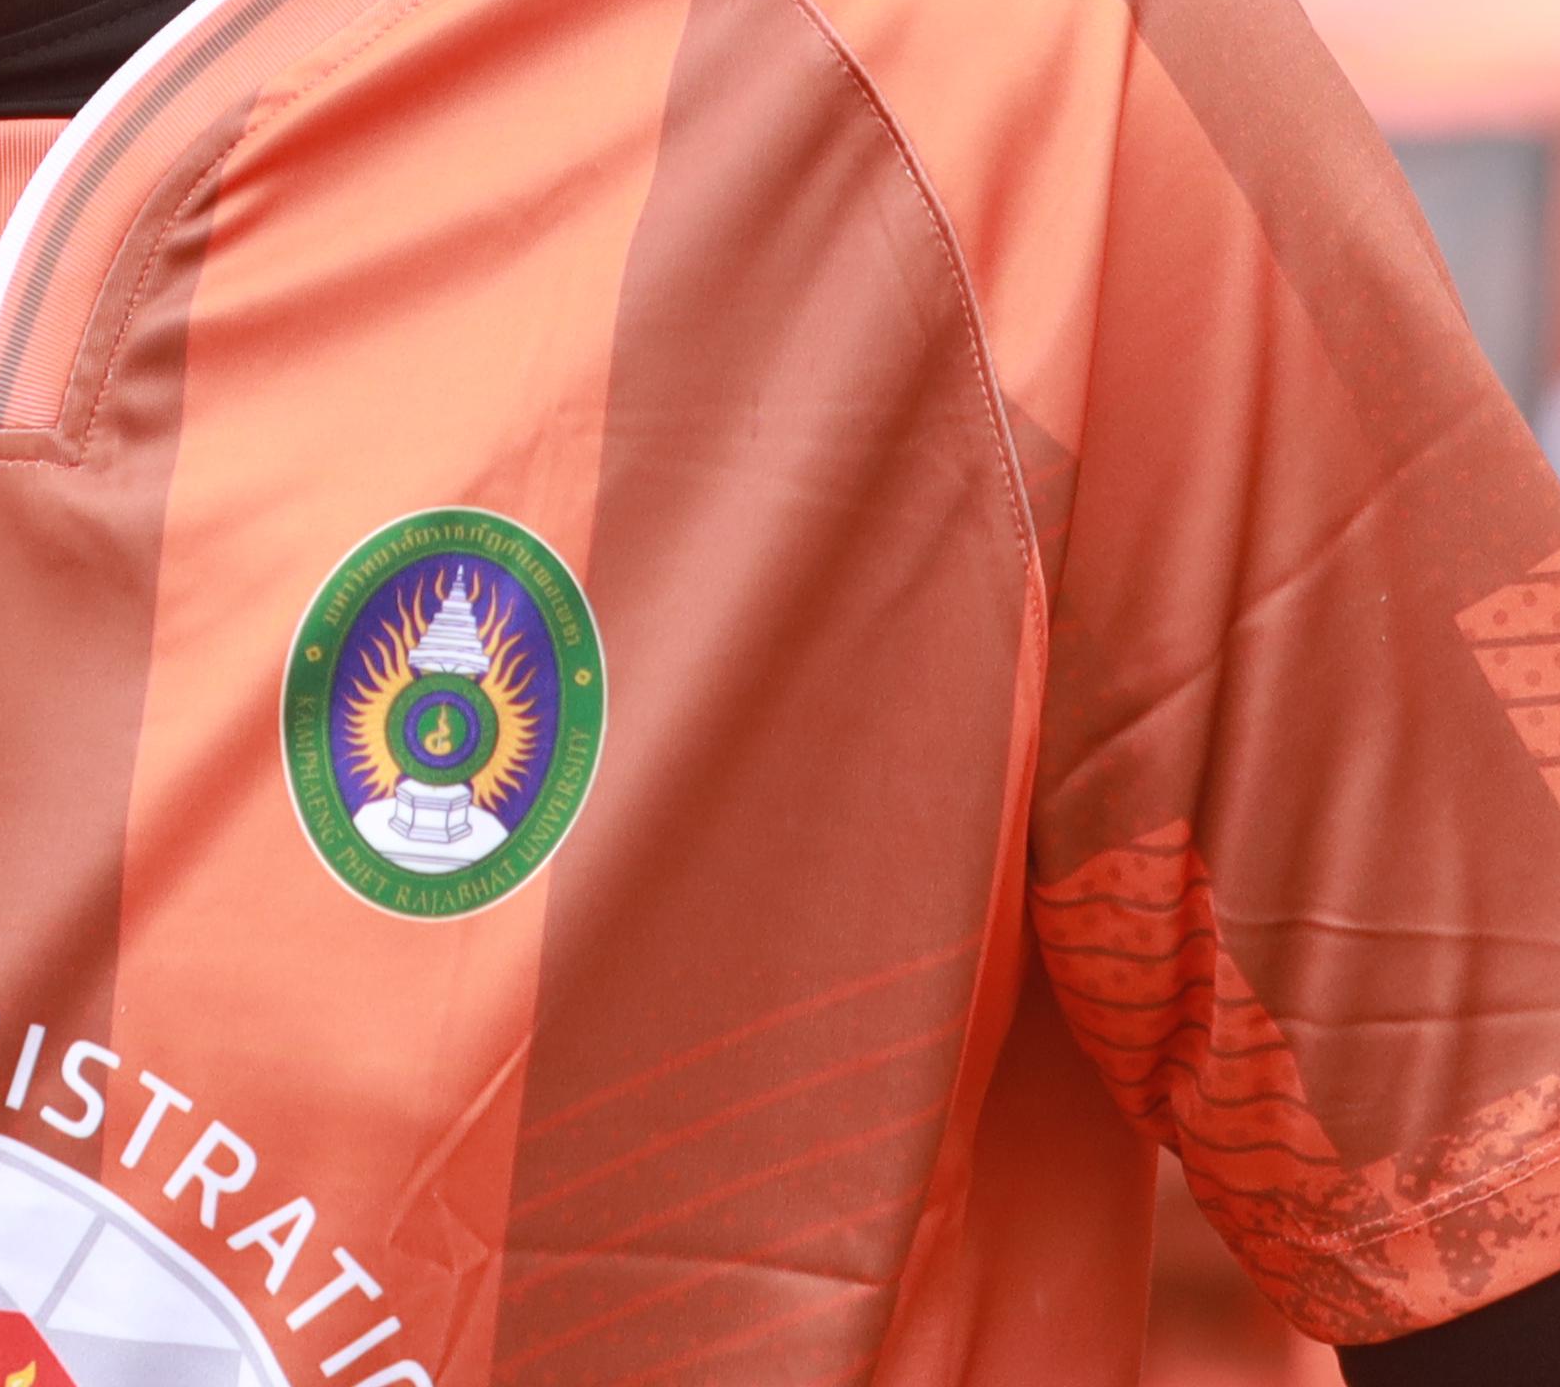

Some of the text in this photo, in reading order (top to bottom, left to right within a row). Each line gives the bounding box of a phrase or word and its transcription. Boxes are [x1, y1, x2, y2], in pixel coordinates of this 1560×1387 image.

[294, 694, 591, 912] KAMPHAENG PHET RAJABHAT UNIVERSITY
